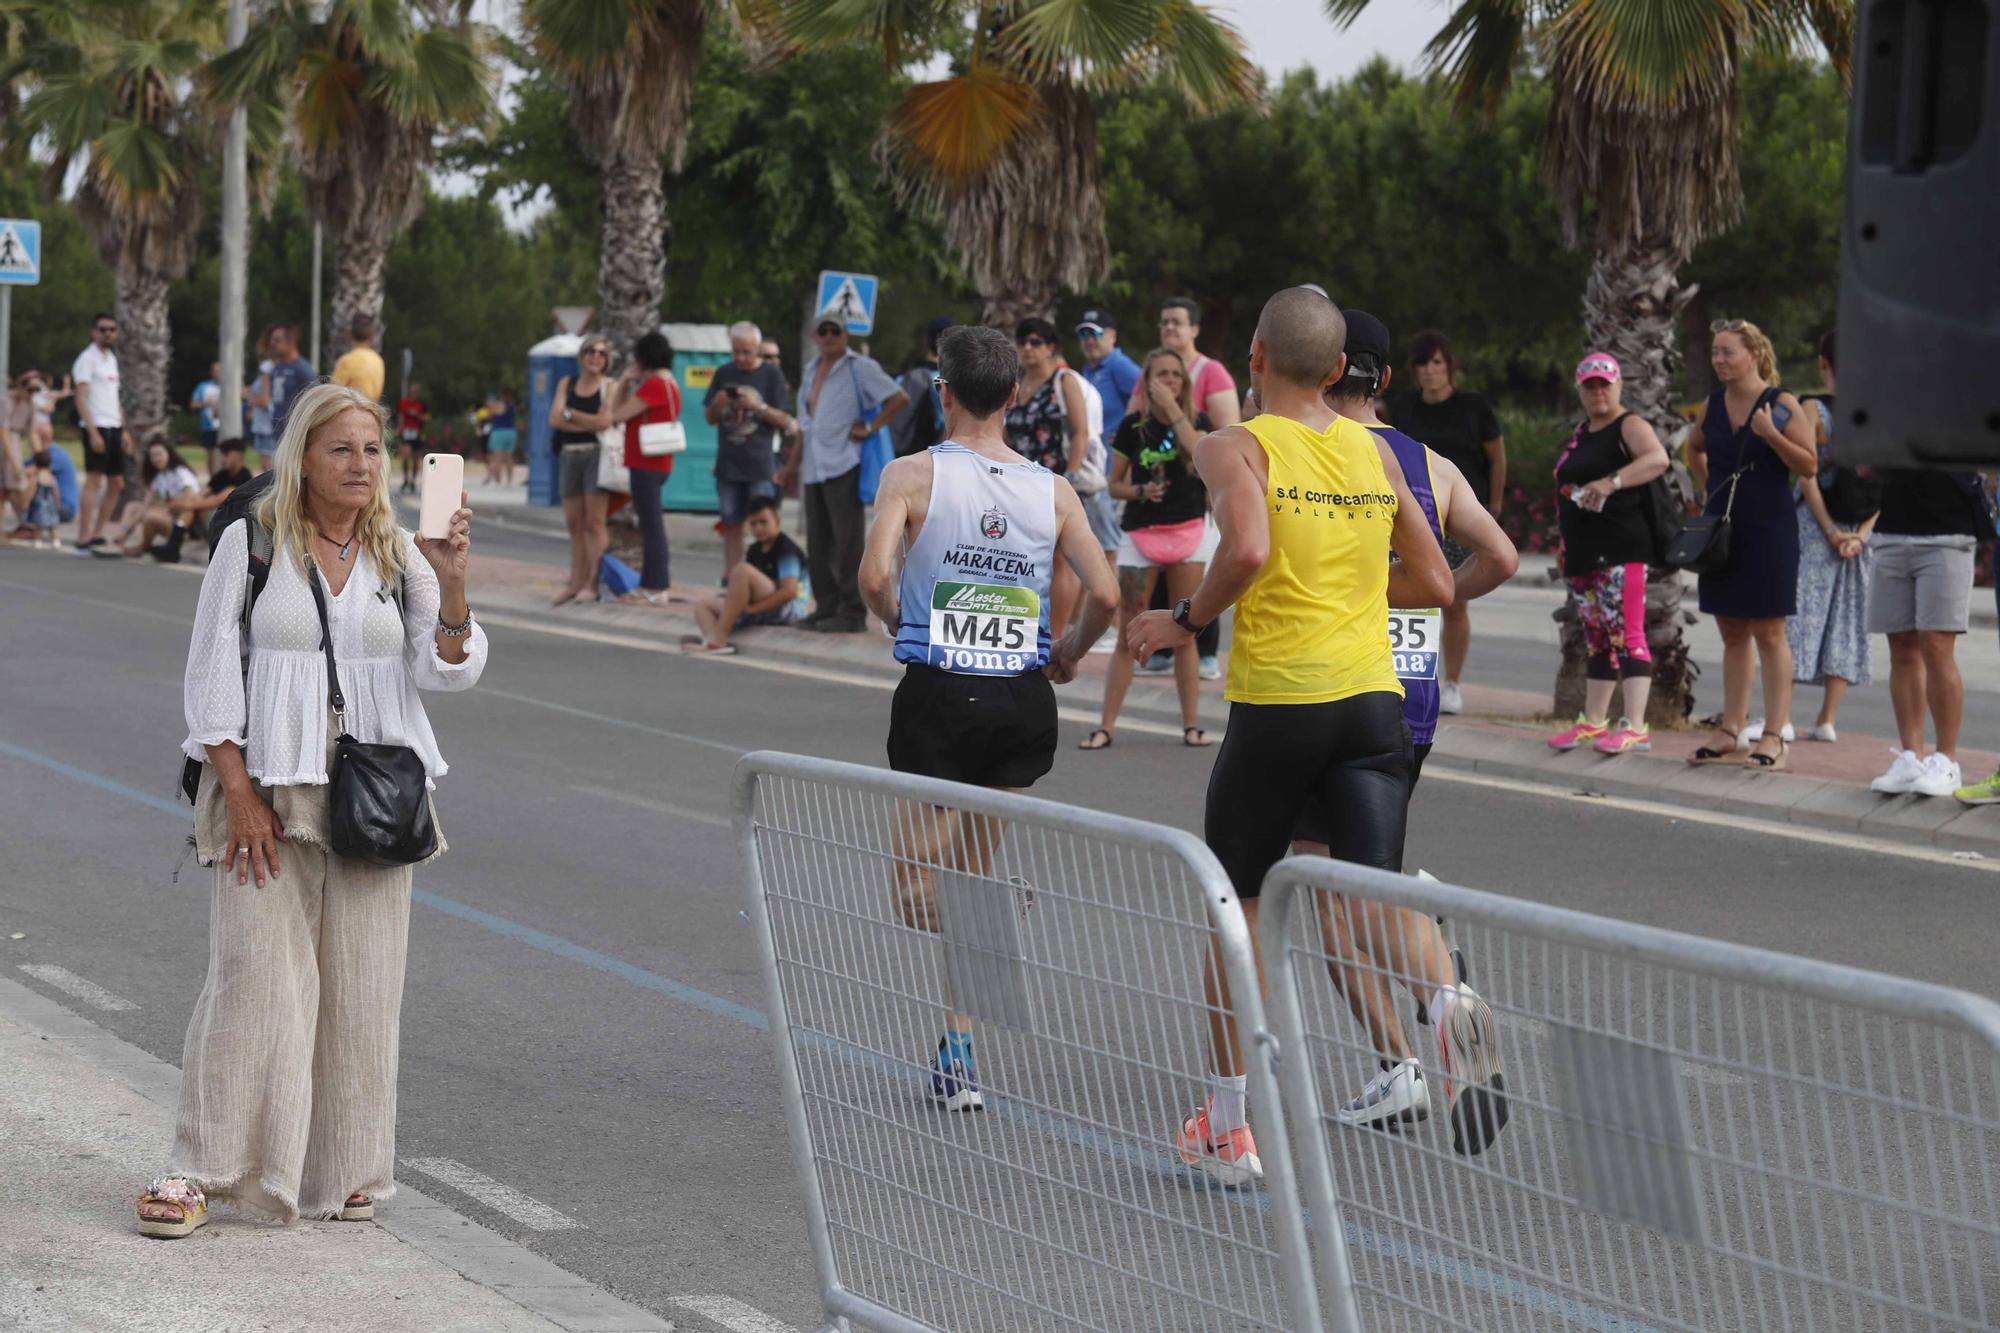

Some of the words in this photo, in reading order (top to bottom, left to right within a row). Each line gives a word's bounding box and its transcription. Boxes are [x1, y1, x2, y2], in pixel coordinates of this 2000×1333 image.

[1305, 490, 1396, 506] correcaminos
[956, 543, 975, 551] CLUB
[987, 548, 1028, 560] ATLETISMO
[942, 550, 1036, 577] MARACENA
[958, 568, 988, 577] GRANADA
[942, 613, 1025, 650] M45
[1388, 616, 1426, 650] 35
